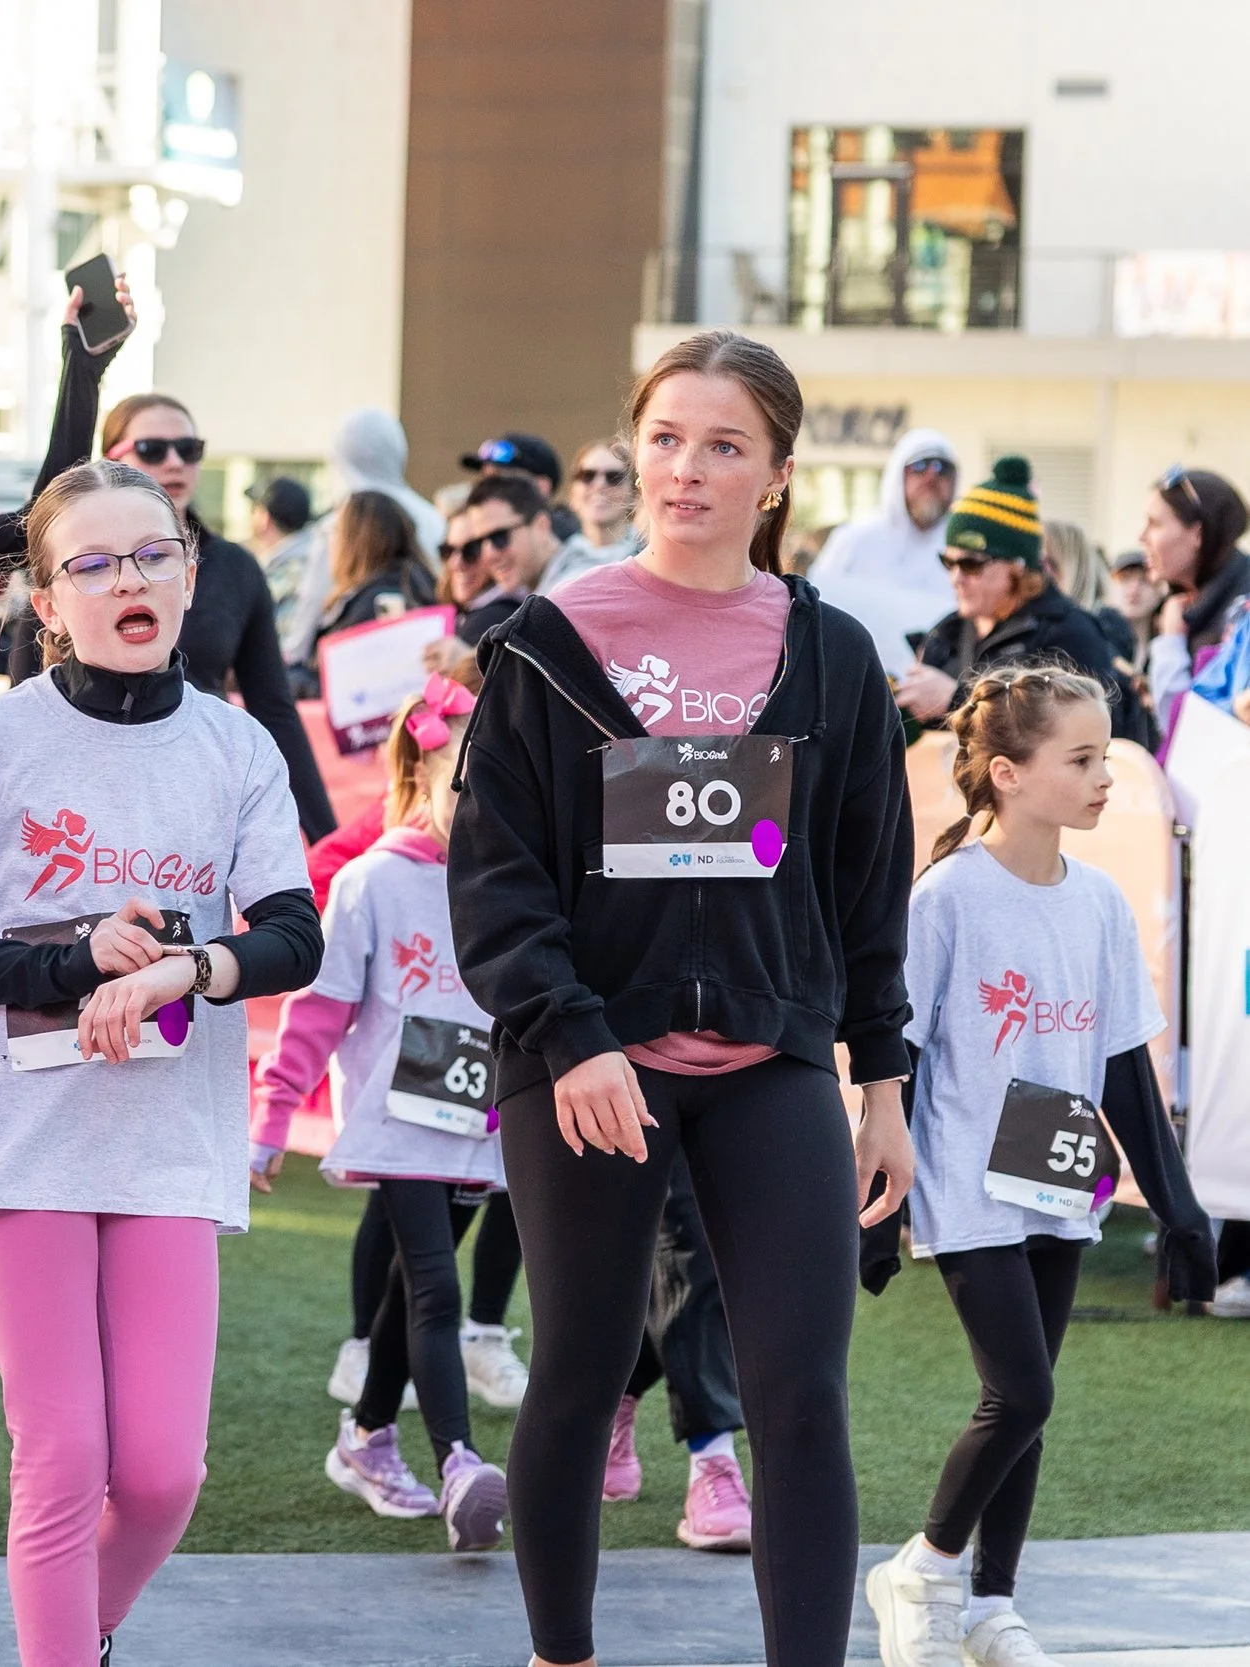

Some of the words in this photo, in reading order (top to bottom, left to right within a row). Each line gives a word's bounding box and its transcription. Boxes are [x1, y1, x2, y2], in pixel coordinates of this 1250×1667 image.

[666, 780, 741, 826] 80
[697, 855, 714, 864] ND
[444, 1056, 488, 1100] 63
[1047, 1130, 1097, 1178] 55
